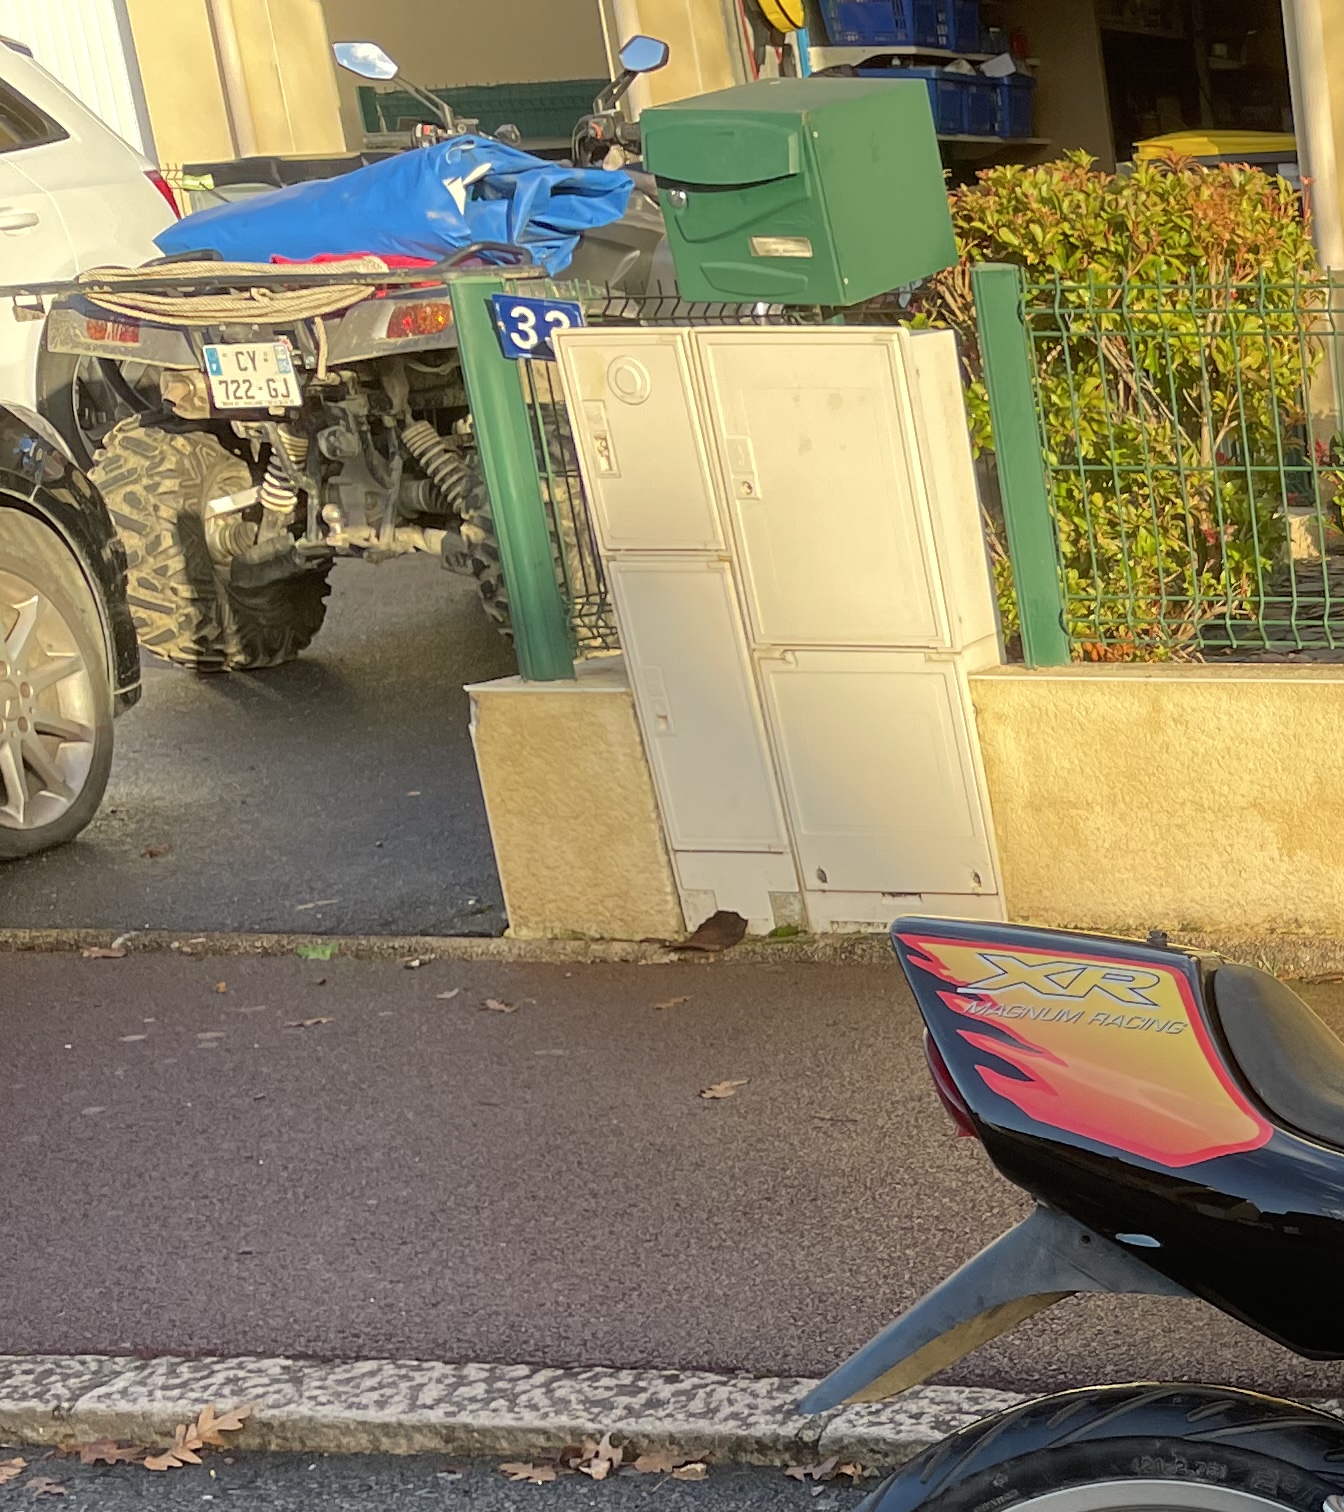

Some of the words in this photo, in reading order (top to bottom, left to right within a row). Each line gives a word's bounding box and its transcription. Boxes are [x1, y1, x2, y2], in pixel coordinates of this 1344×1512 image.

[234, 350, 258, 372] CY
[957, 952, 1161, 1009] XR
[963, 1000, 1086, 1024] MAGNUM
[1088, 1011, 1189, 1035] RACING
